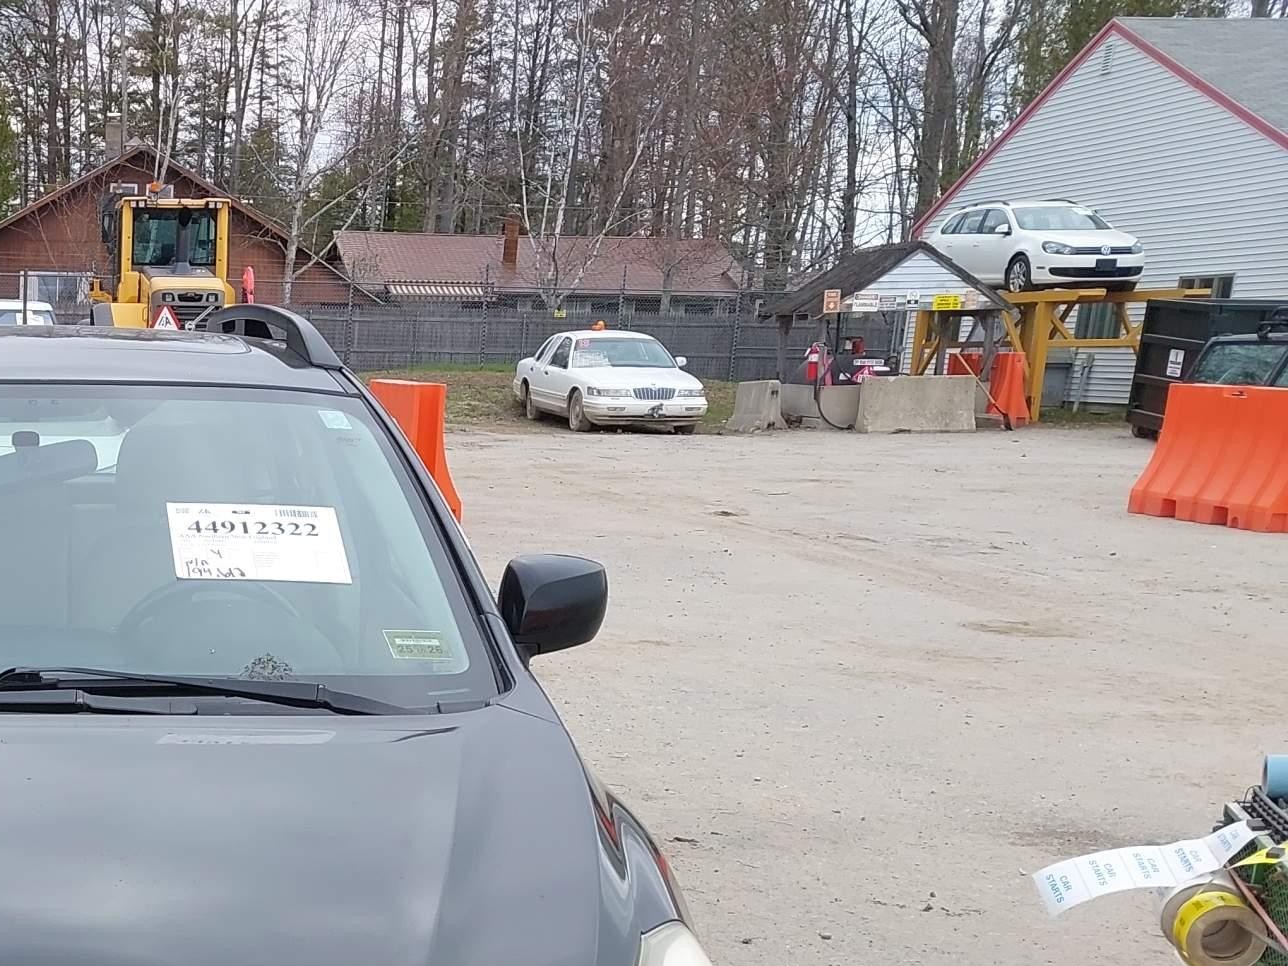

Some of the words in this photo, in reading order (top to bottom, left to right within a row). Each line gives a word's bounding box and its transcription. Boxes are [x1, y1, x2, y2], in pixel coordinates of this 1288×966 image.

[188, 520, 319, 537] 44912322
[1088, 859, 1108, 887] STARTS
[1103, 863, 1117, 880] CAR
[1132, 852, 1152, 880] STARTS
[1174, 847, 1194, 873] STARTS
[1045, 873, 1065, 903] STARTS
[1058, 875, 1073, 891] CAR
